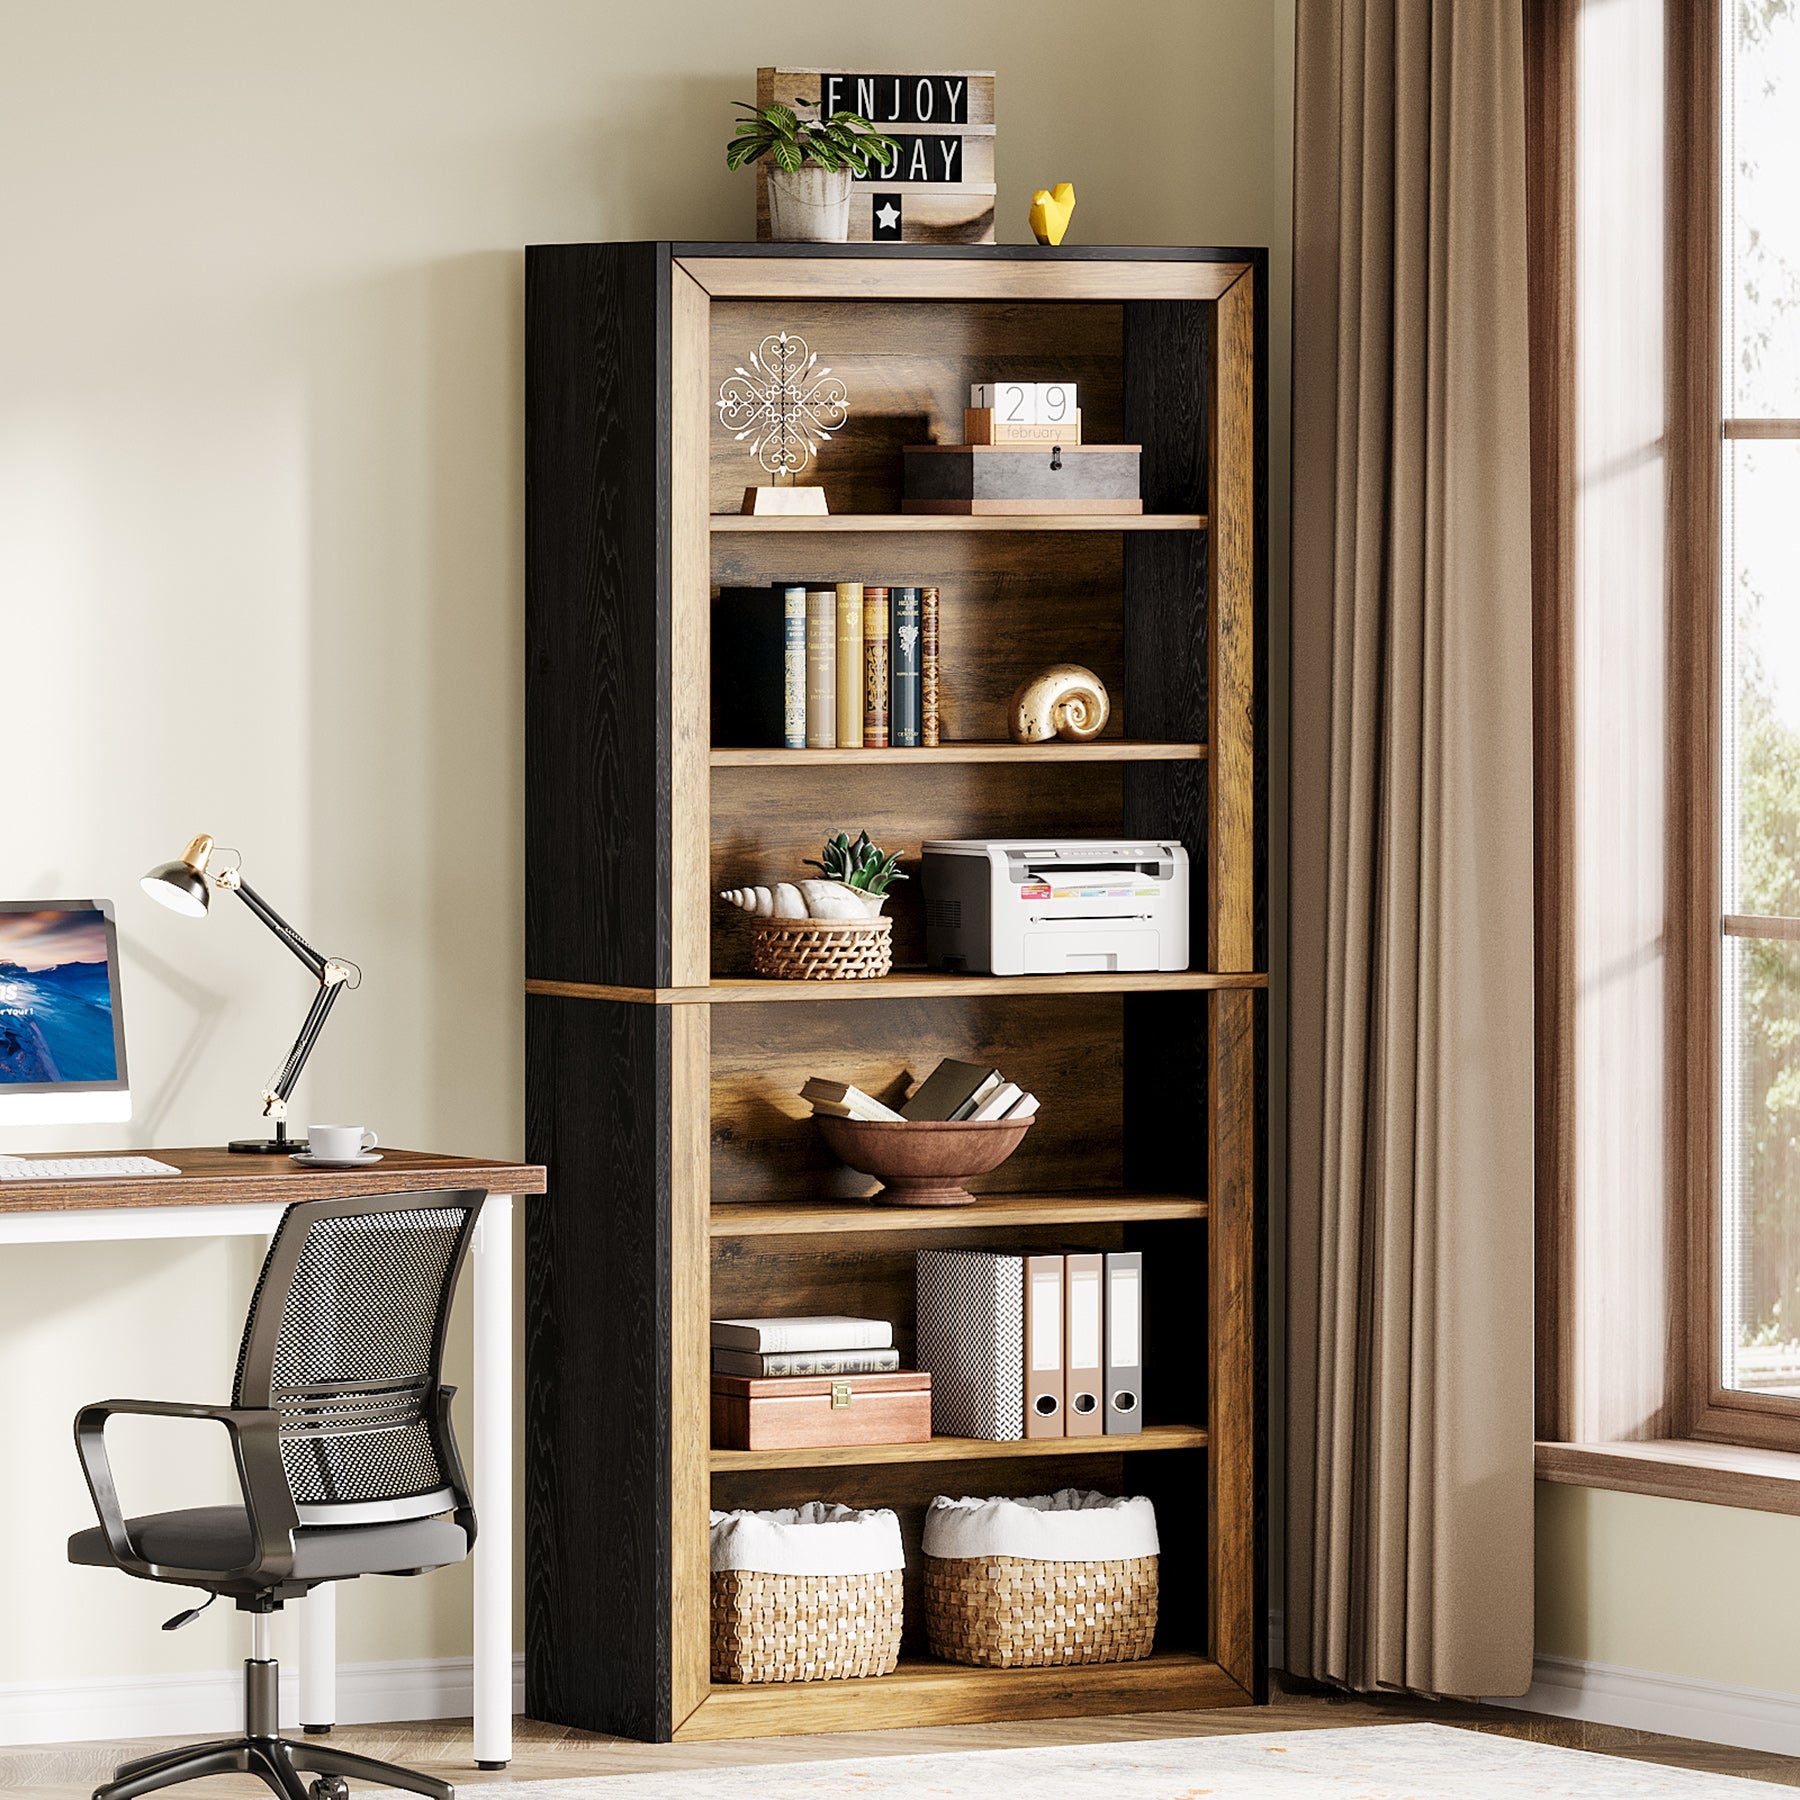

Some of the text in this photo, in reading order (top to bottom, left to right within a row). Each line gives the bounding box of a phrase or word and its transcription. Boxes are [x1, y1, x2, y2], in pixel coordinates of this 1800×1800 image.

[828, 77, 963, 123] ENJOY
[852, 138, 958, 182] ODAY
[1006, 425, 1062, 440] february
